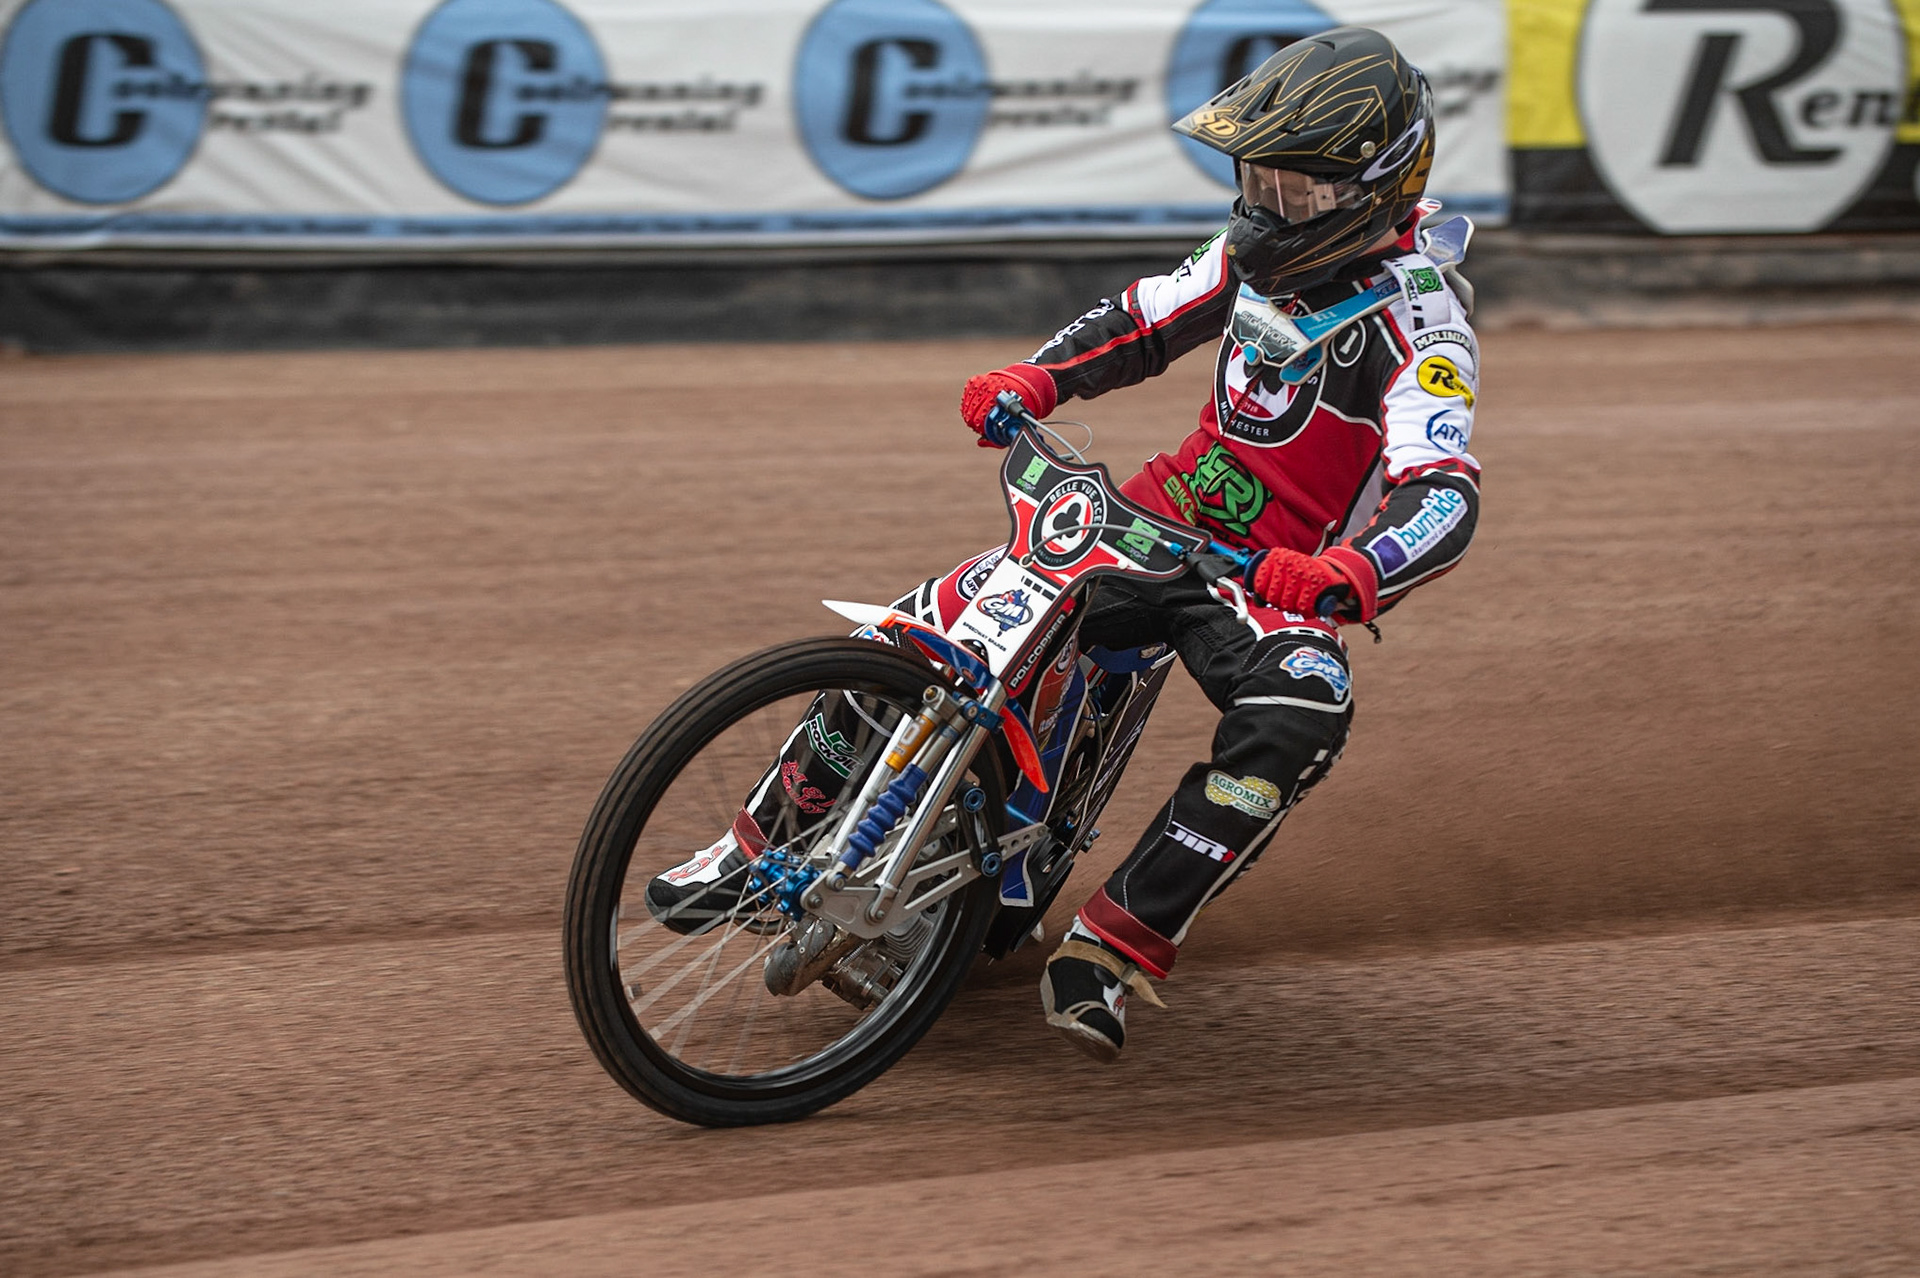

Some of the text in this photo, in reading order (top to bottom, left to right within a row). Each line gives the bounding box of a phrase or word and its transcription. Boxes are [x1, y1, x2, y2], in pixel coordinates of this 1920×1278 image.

[1049, 481, 1079, 503] BELLE
[1081, 482, 1098, 500] VUE
[1010, 613, 1067, 688] POLCOPPER
[1211, 775, 1273, 808] AGROMIX
